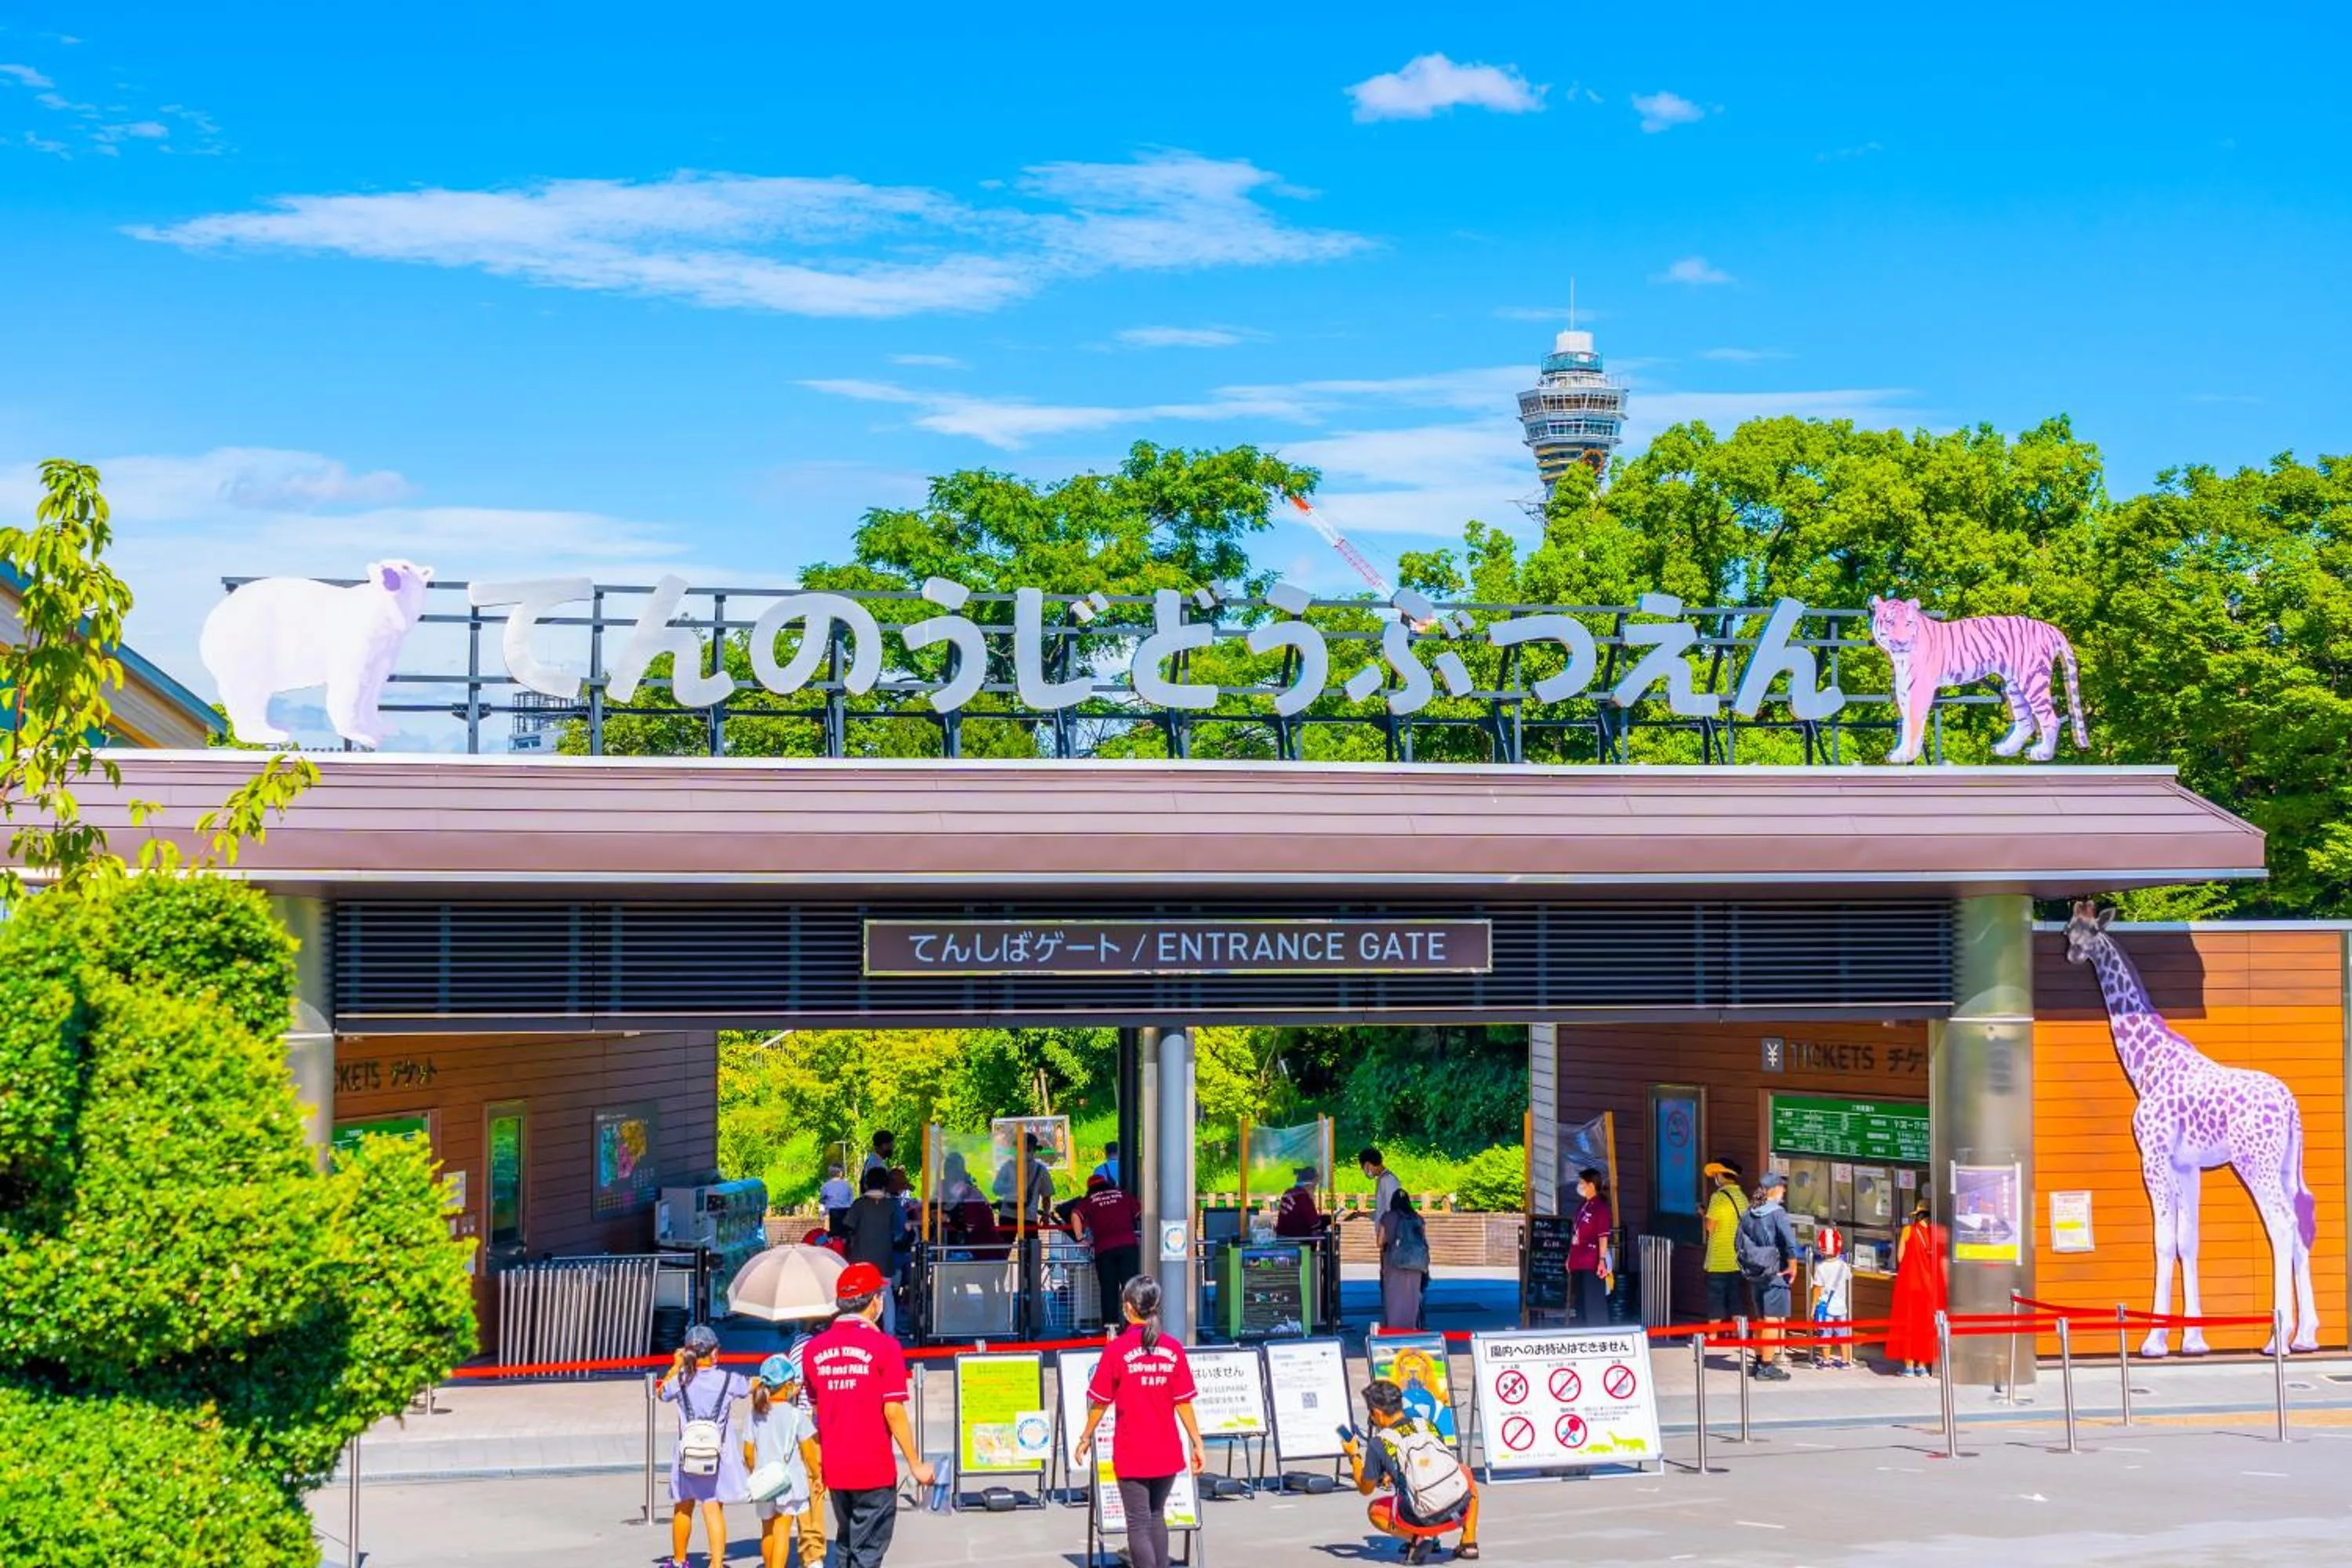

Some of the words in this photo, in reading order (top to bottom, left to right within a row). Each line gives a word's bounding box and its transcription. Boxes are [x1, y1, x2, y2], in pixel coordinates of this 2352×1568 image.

[468, 574, 1845, 719] てんのうじどうぶつえん
[908, 930, 1121, 964] てんしばゲート
[1158, 932, 1345, 963] ENTRANCE
[1359, 931, 1447, 961] GATE
[1791, 1043, 1875, 1069] TICKETS
[1888, 1046, 1926, 1073] チケ
[1490, 1341, 1629, 1357] 園内へのお持込はできません
[827, 1379, 857, 1391] STAFF
